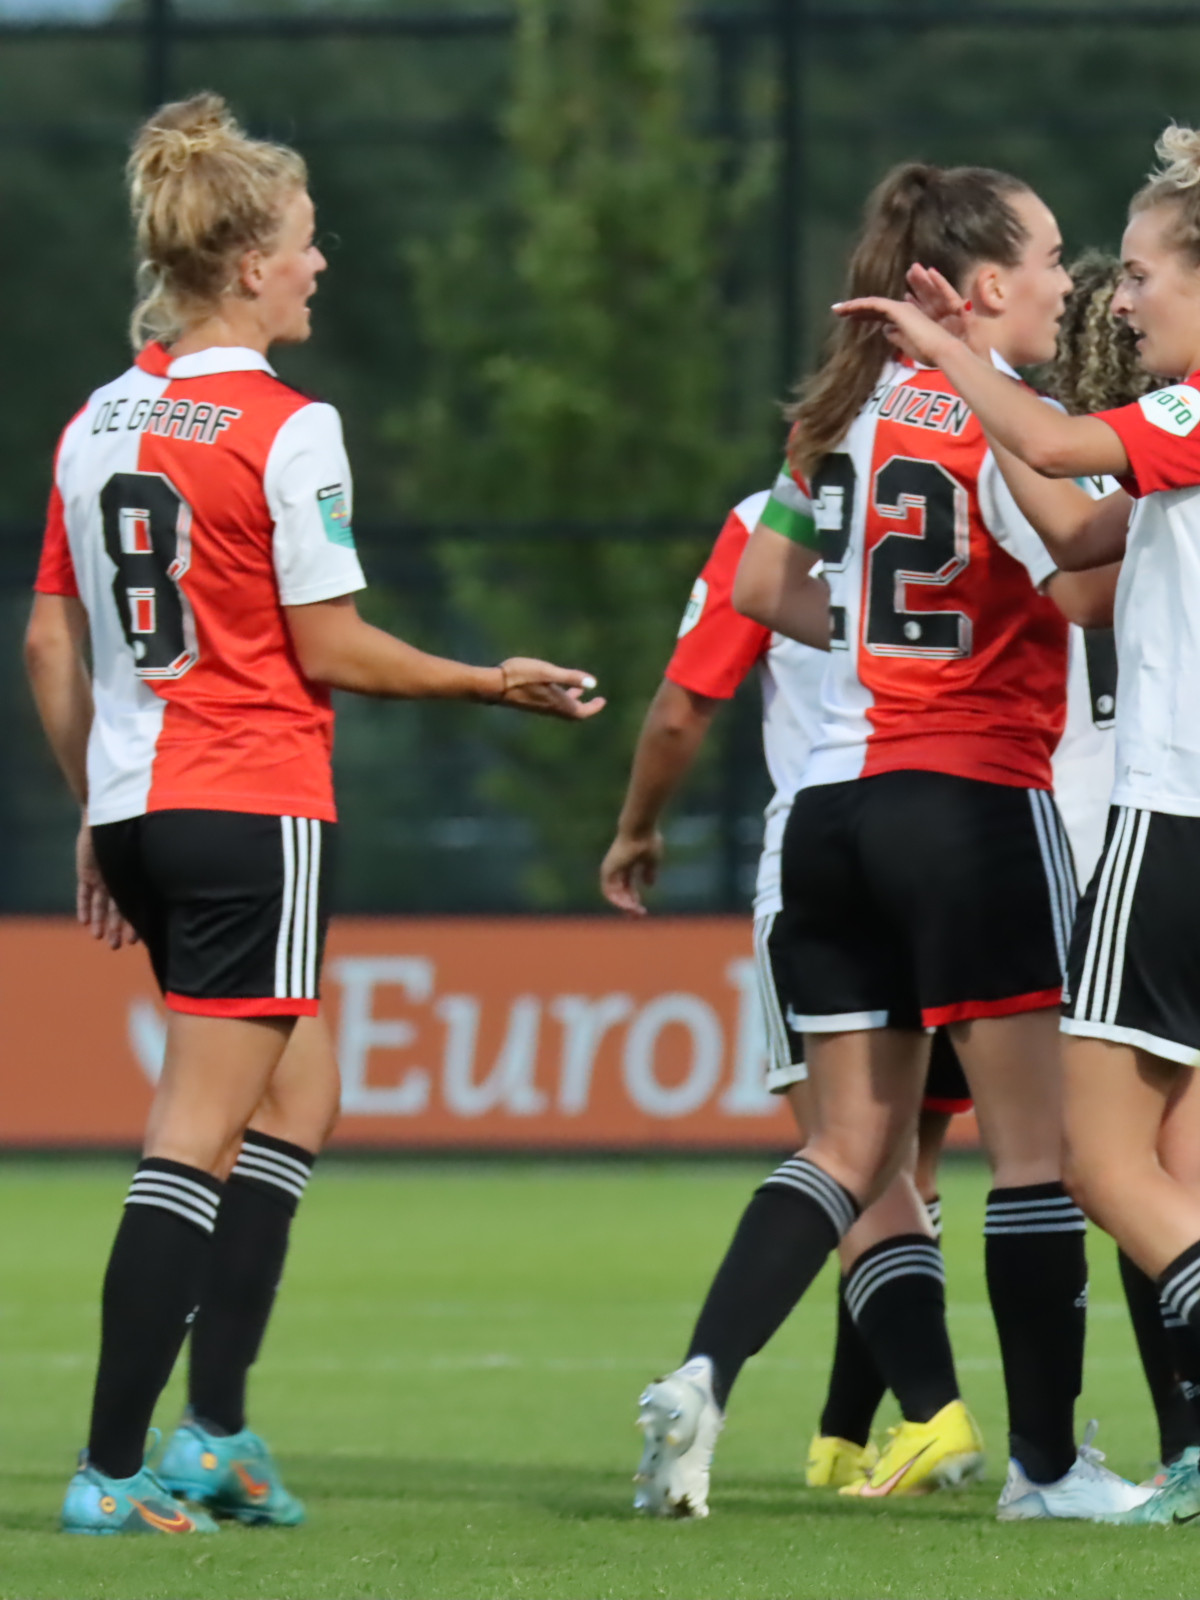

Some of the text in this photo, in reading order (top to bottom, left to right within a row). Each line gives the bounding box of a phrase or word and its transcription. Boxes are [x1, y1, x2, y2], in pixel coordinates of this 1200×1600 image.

[92, 398, 243, 445] DE GRAAF
[1149, 390, 1192, 426] TOTO
[100, 472, 198, 680] 8
